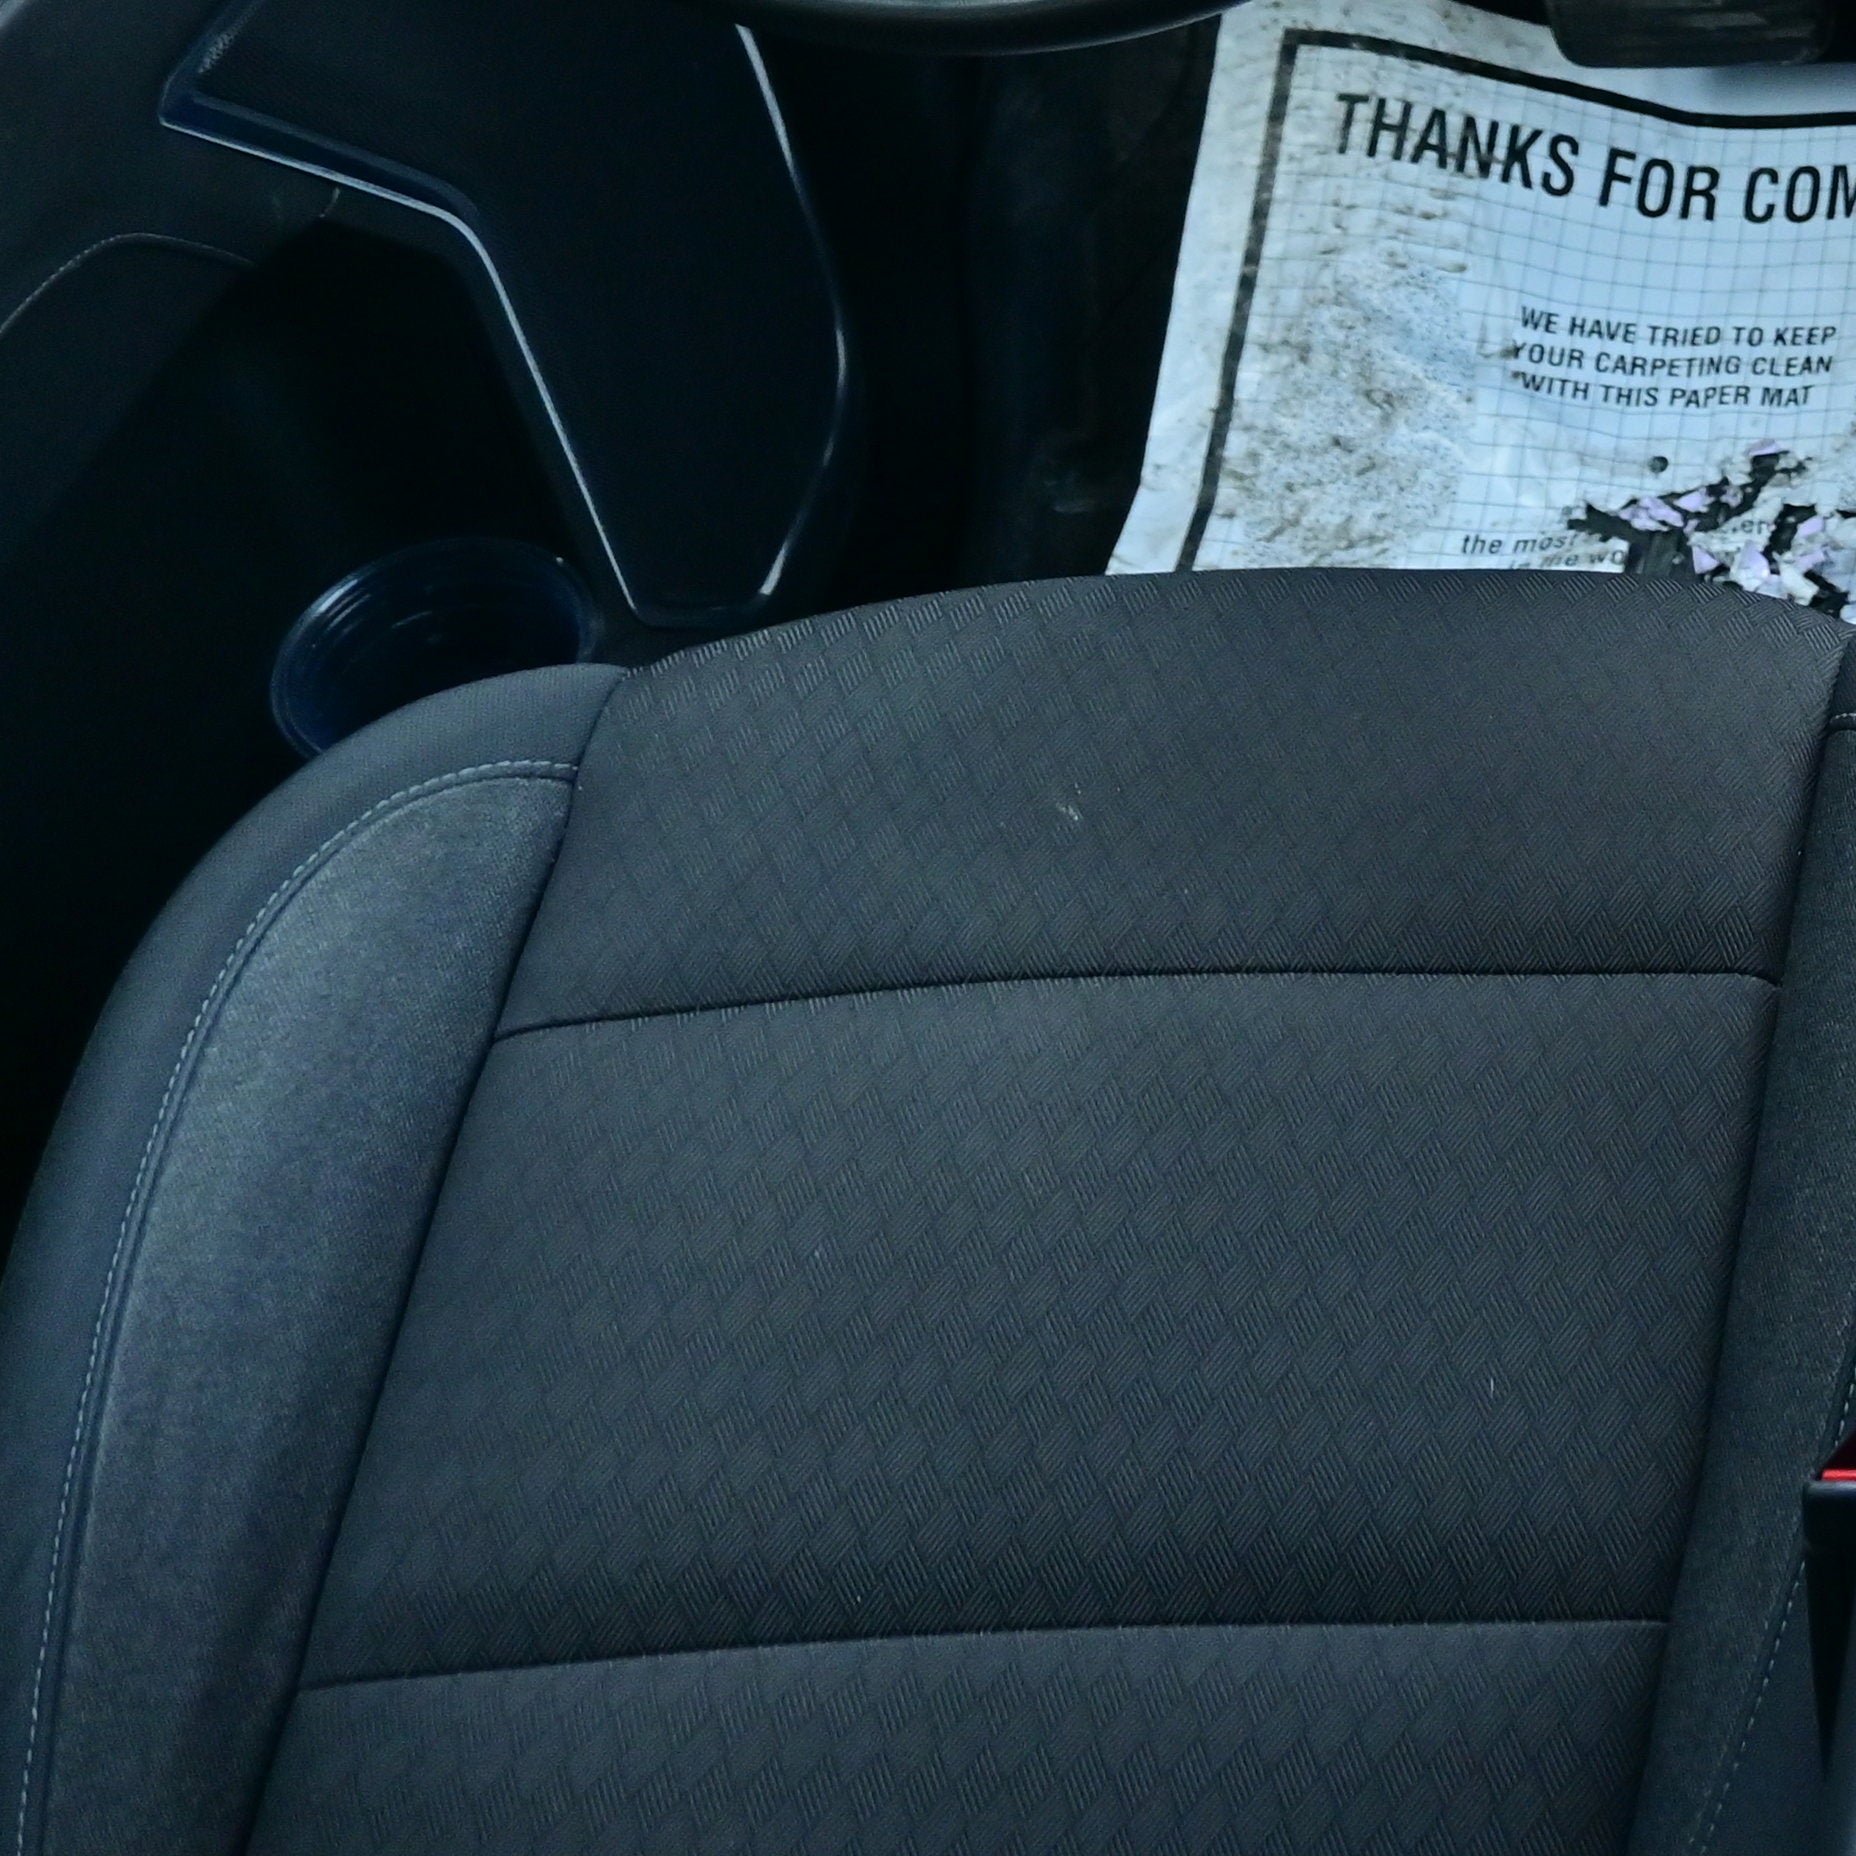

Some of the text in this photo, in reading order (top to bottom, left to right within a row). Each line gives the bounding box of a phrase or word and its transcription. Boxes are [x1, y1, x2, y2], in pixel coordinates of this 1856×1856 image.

[1336, 92, 1580, 198] THANKS
[1598, 146, 1721, 222] FOR
[1520, 305, 1838, 348] WE HAVE TRIED TO KEEP
[1512, 339, 1834, 379] YOUR CARPETING CLEAN
[1518, 371, 1815, 409] WITH THIS PAPER MAT
[1461, 534, 1503, 554] the
